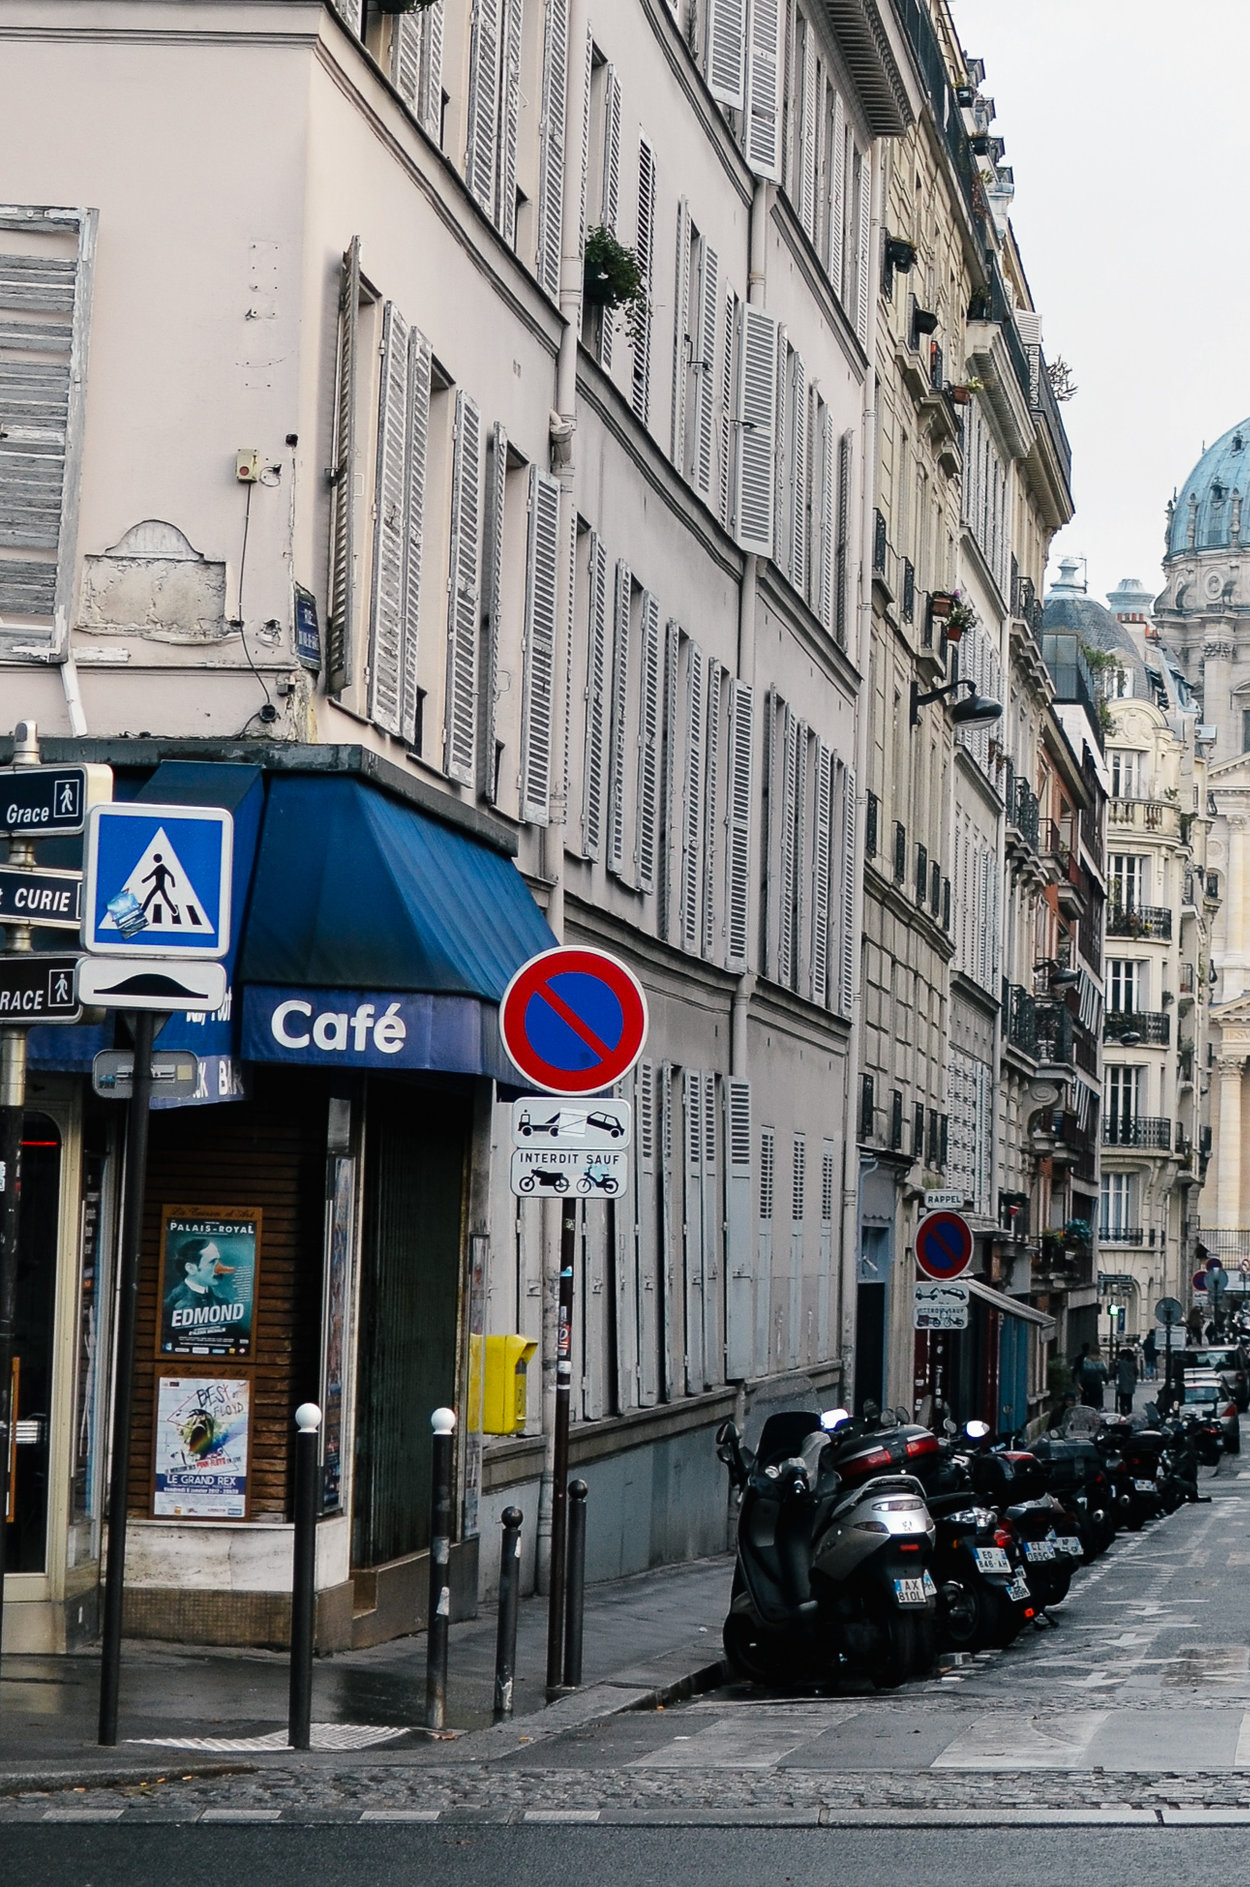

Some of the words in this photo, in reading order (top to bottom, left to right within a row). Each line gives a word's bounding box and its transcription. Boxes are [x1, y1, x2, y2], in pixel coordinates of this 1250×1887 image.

[7, 803, 50, 824] Grace
[14, 887, 71, 912] CURIE
[0, 989, 44, 1011] RACE
[270, 999, 407, 1054] Café
[520, 1153, 579, 1164] INTERDIT
[586, 1154, 620, 1165] SAUF
[927, 1195, 962, 1204] RAPPEL
[170, 1221, 255, 1234] PALAIS-ROYAL
[171, 1303, 245, 1327] EDMOND
[167, 1474, 179, 1484] LE
[180, 1475, 215, 1485] GRAND
[217, 1476, 237, 1486] REX
[904, 1580, 920, 1591] AX
